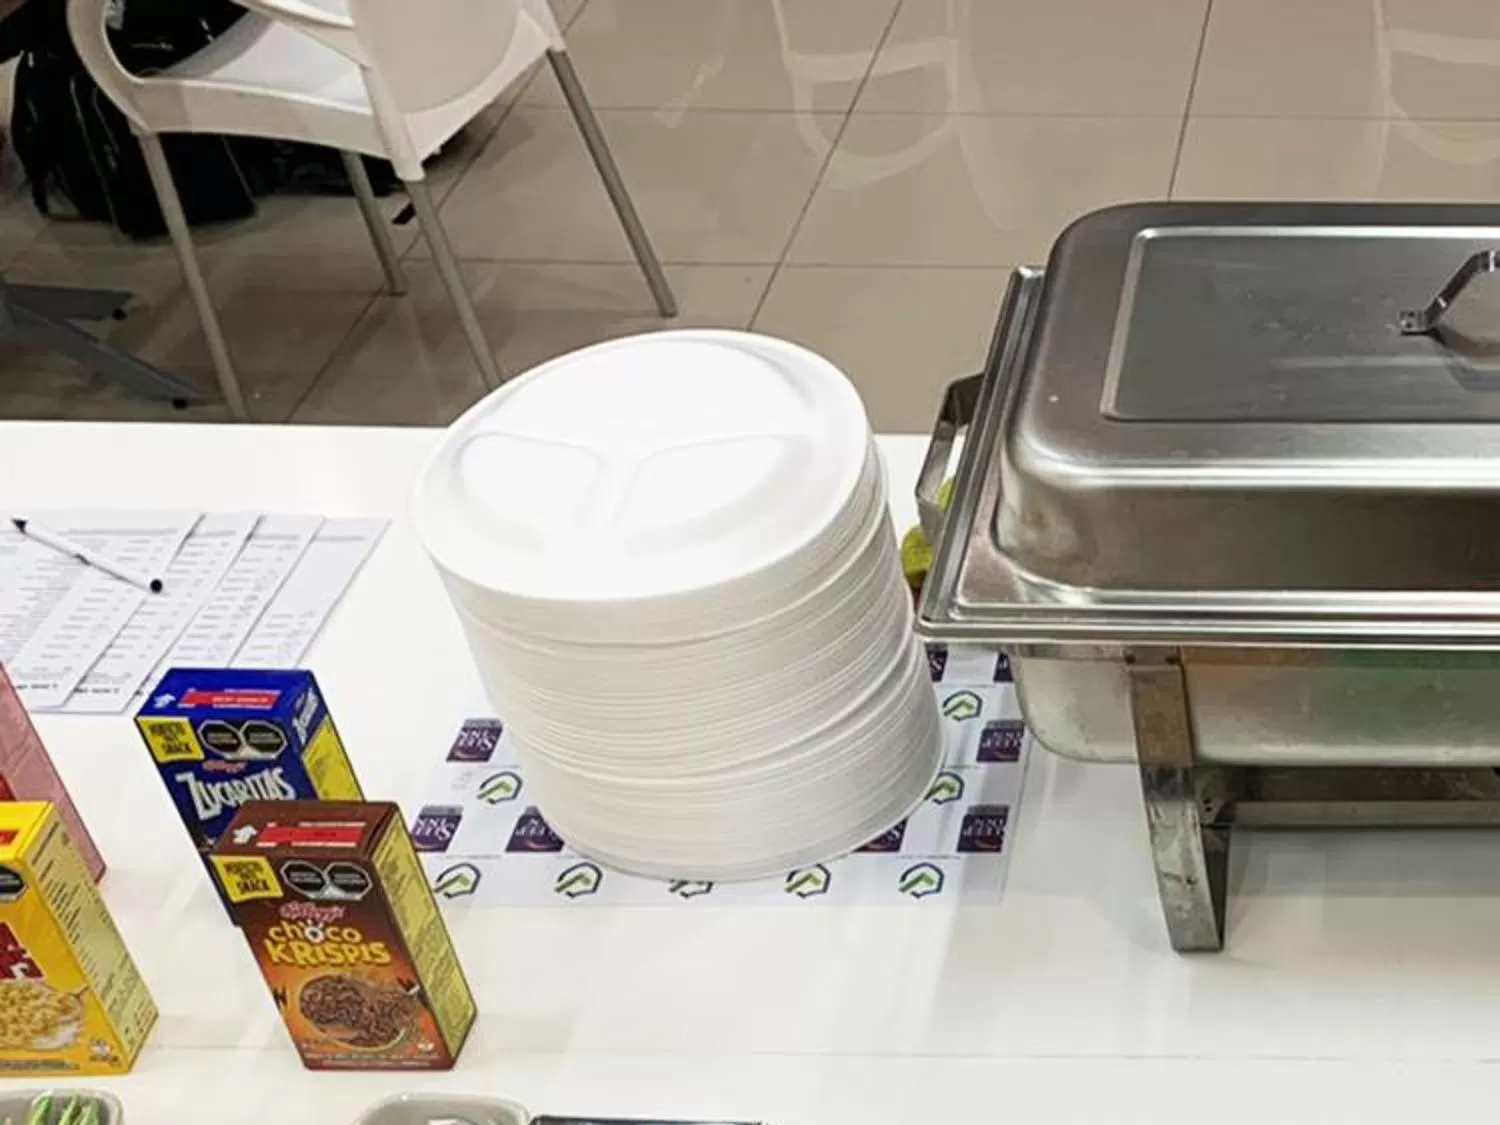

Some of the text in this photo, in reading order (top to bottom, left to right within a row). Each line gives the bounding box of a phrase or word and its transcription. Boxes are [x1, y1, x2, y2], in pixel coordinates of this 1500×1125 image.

[175, 768, 297, 821] ZUCARITAS
[268, 920, 363, 944] choco
[264, 939, 392, 966] KRISPIS
